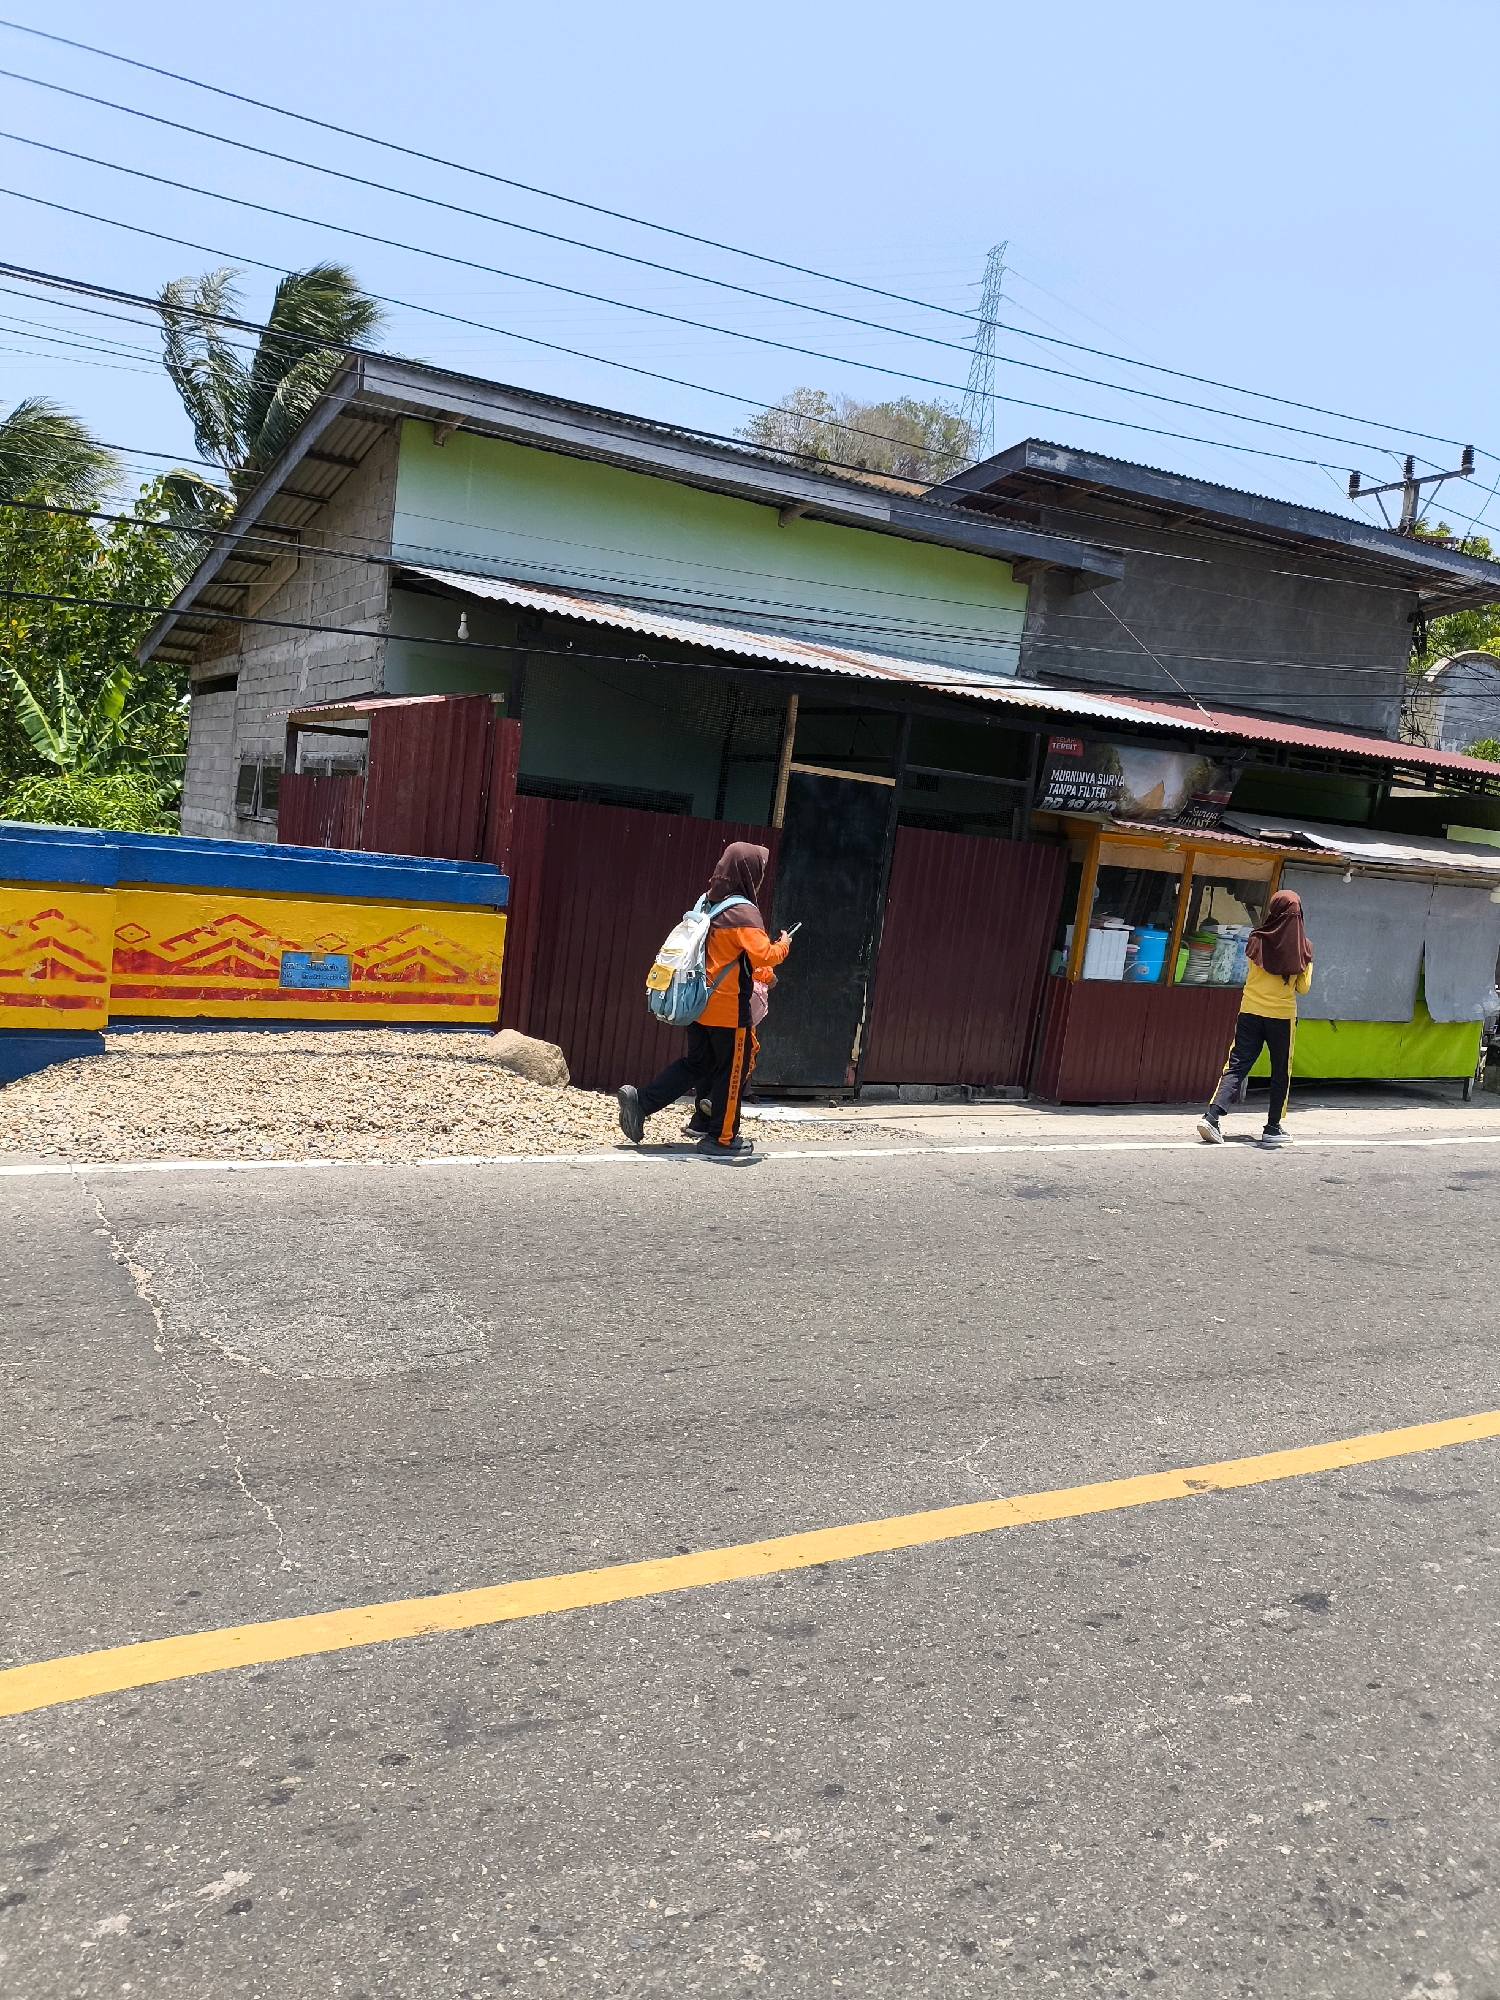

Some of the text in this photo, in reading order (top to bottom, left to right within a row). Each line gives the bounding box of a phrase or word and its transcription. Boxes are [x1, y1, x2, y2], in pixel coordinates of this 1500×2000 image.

[1052, 742, 1078, 750] TERBIT
[1050, 769, 1125, 787] MURNINYA SURYA
[1048, 783, 1107, 799] TANPA FILTER
